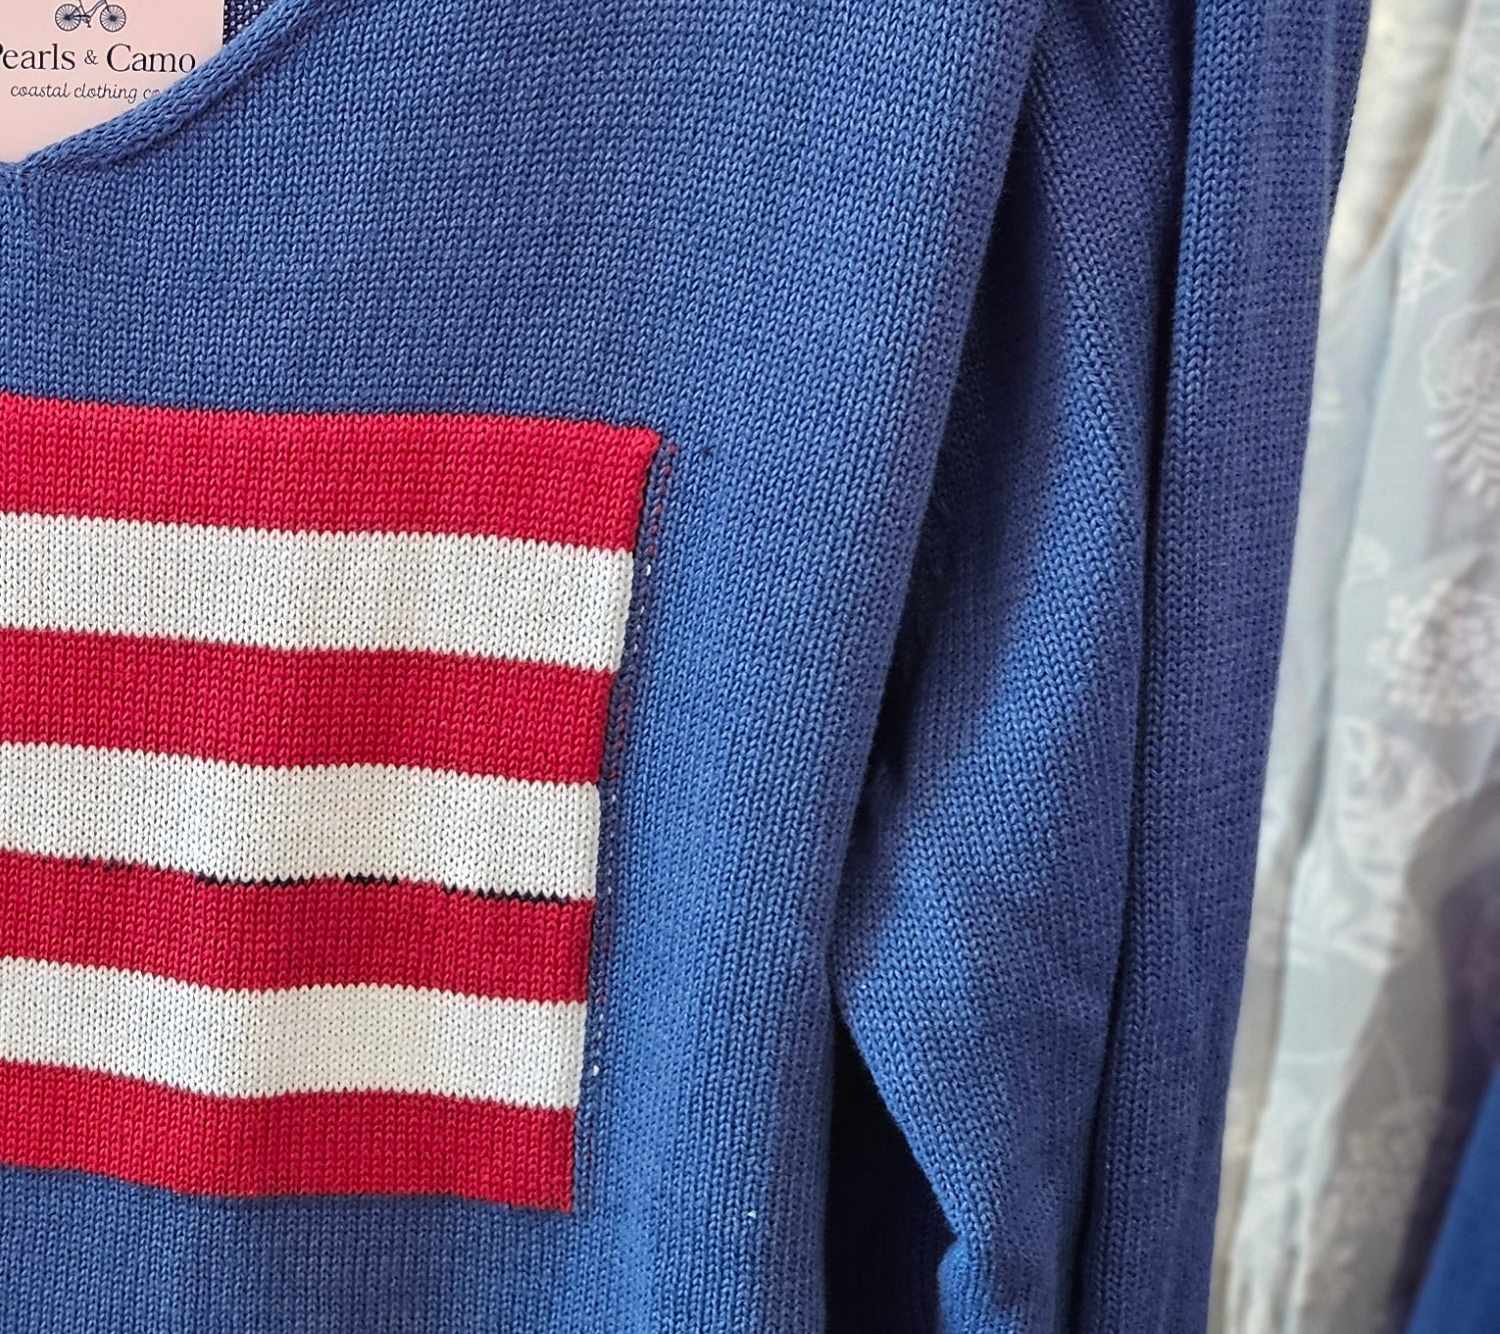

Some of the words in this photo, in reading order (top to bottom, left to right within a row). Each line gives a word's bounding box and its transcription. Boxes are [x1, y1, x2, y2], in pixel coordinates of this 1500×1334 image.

[83, 49, 99, 66] &
[106, 43, 196, 73] Camo
[10, 82, 72, 99] coastal
[73, 83, 138, 104] clothing
